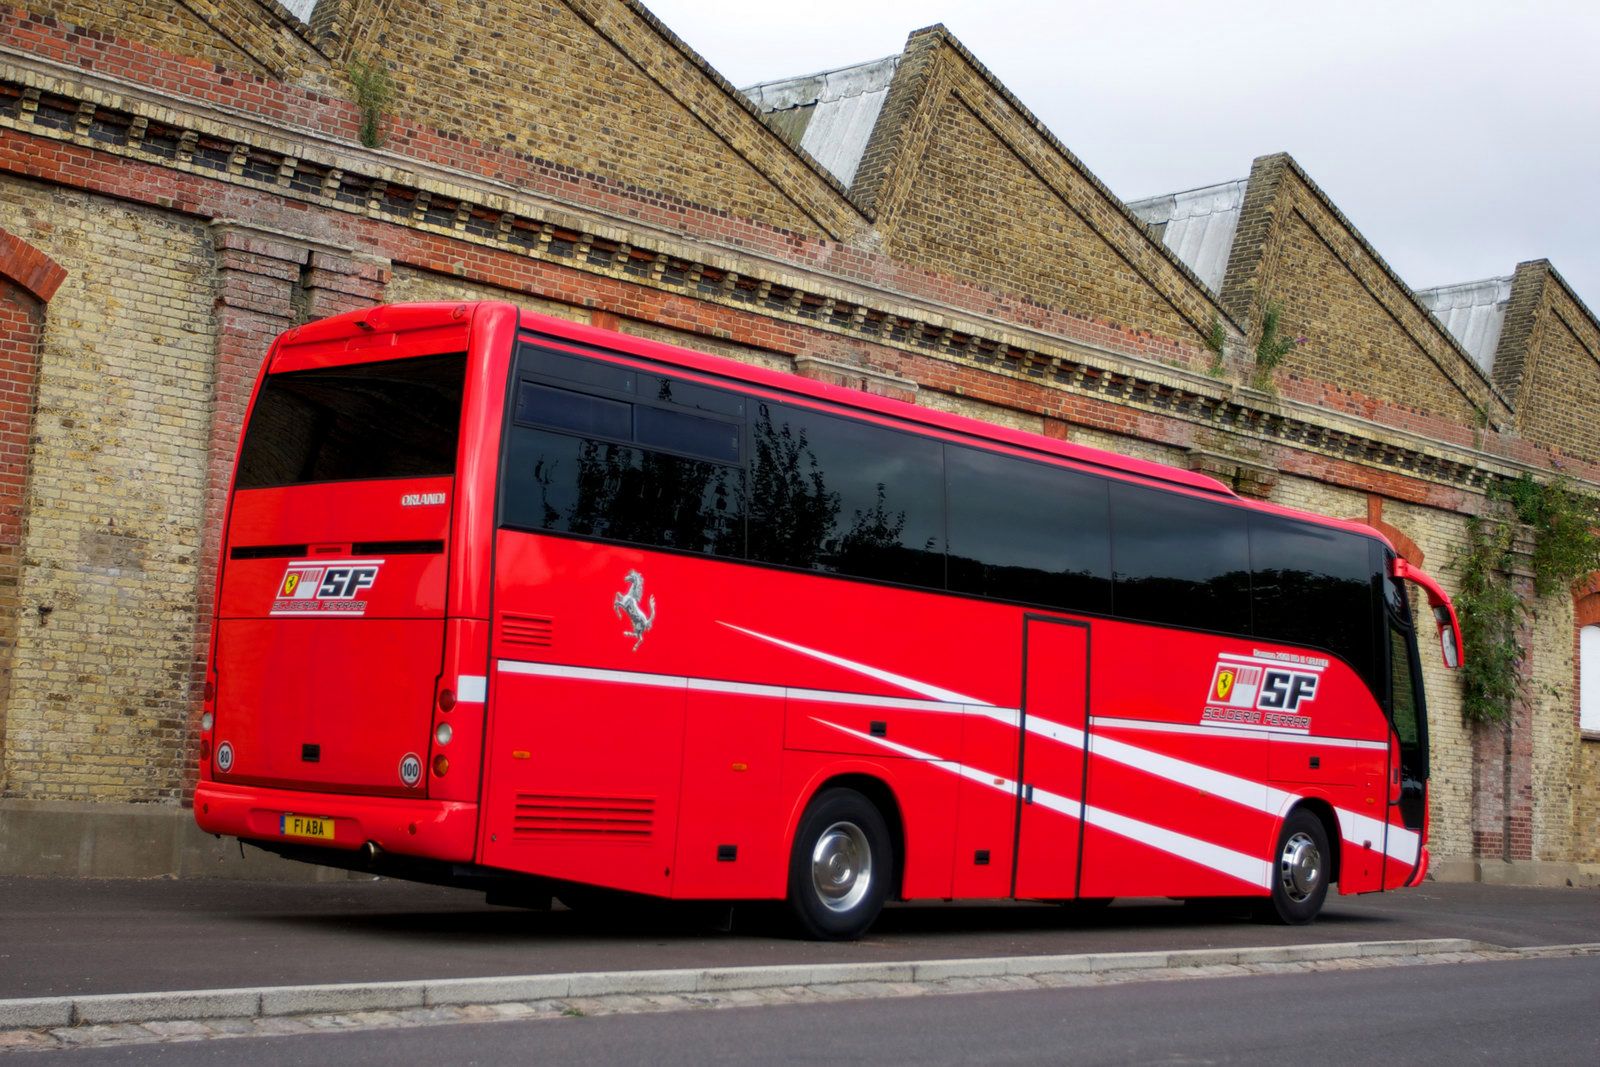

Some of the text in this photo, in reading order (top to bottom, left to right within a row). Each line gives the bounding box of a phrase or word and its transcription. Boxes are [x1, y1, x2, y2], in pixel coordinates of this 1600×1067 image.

[401, 493, 446, 506] ORLANDI
[316, 567, 378, 599] SF
[322, 600, 367, 609] FERRARI
[1257, 667, 1319, 713] SF
[1202, 707, 1311, 728] SCUDERIA FERRARI
[220, 750, 230, 763] 80
[404, 763, 418, 777] 100
[306, 820, 324, 836] ABA
